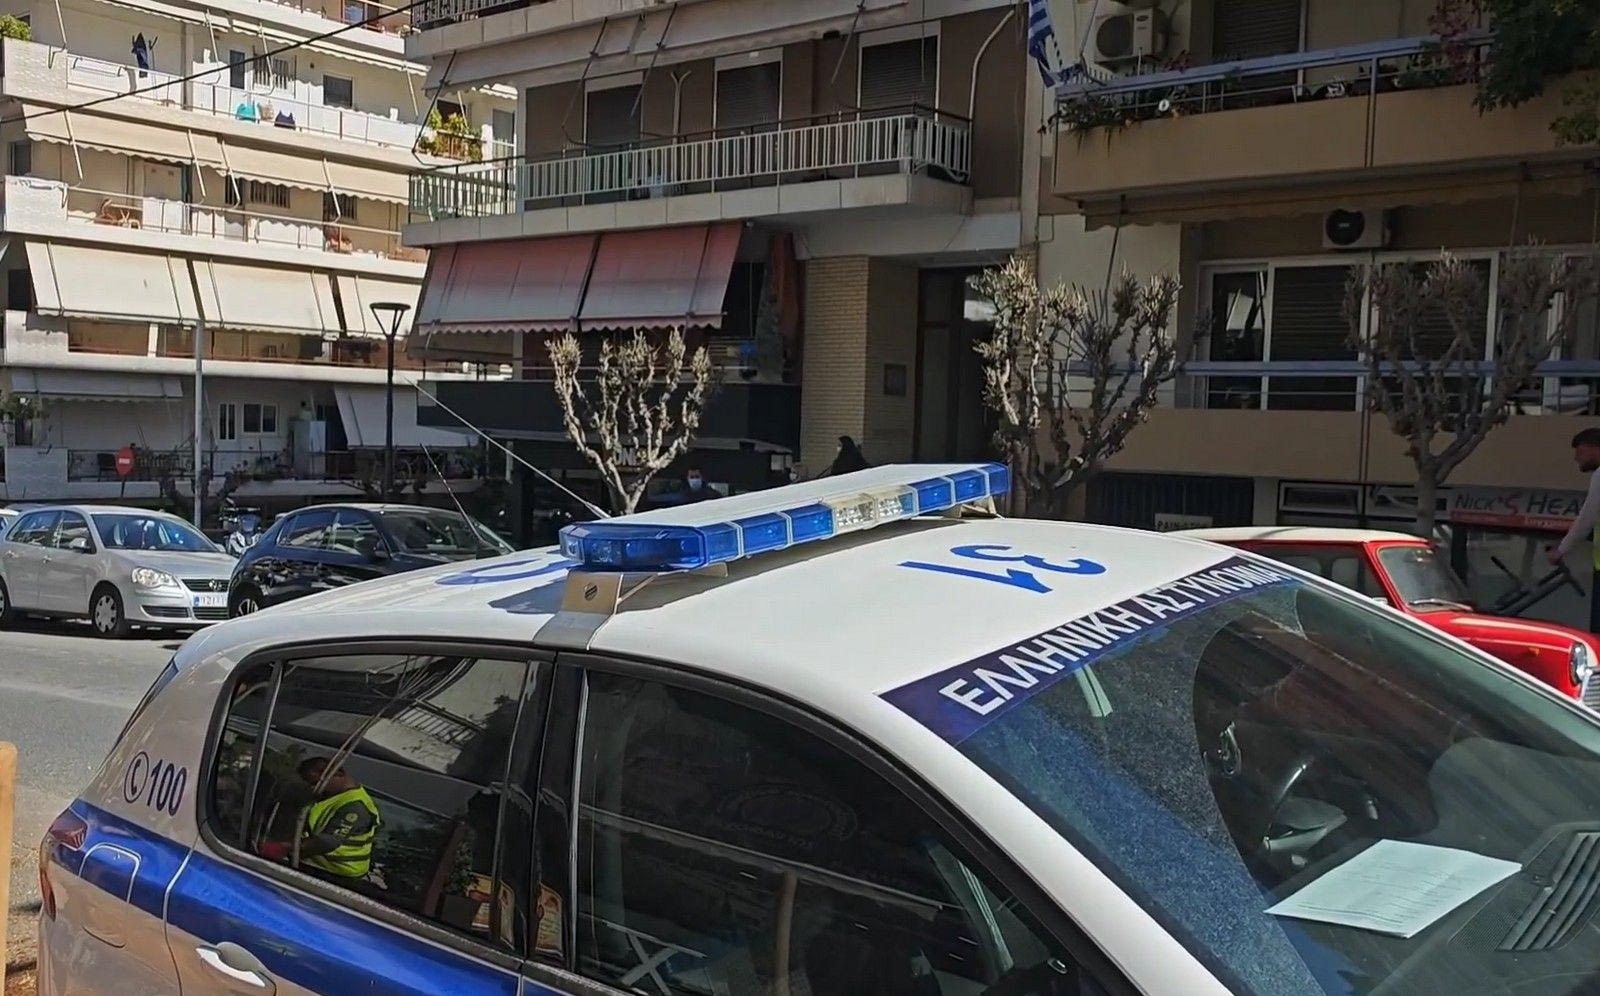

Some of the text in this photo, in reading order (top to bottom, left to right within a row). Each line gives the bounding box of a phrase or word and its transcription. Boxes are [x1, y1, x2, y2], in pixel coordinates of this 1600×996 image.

[1455, 492, 1585, 516] NICK'S HEA
[897, 544, 1107, 594] 31
[939, 562, 1292, 716] ΕΛΛΗΝΙΚΗ ΑΣΤΥΝΟΜΙΑ
[147, 759, 187, 816] 100
